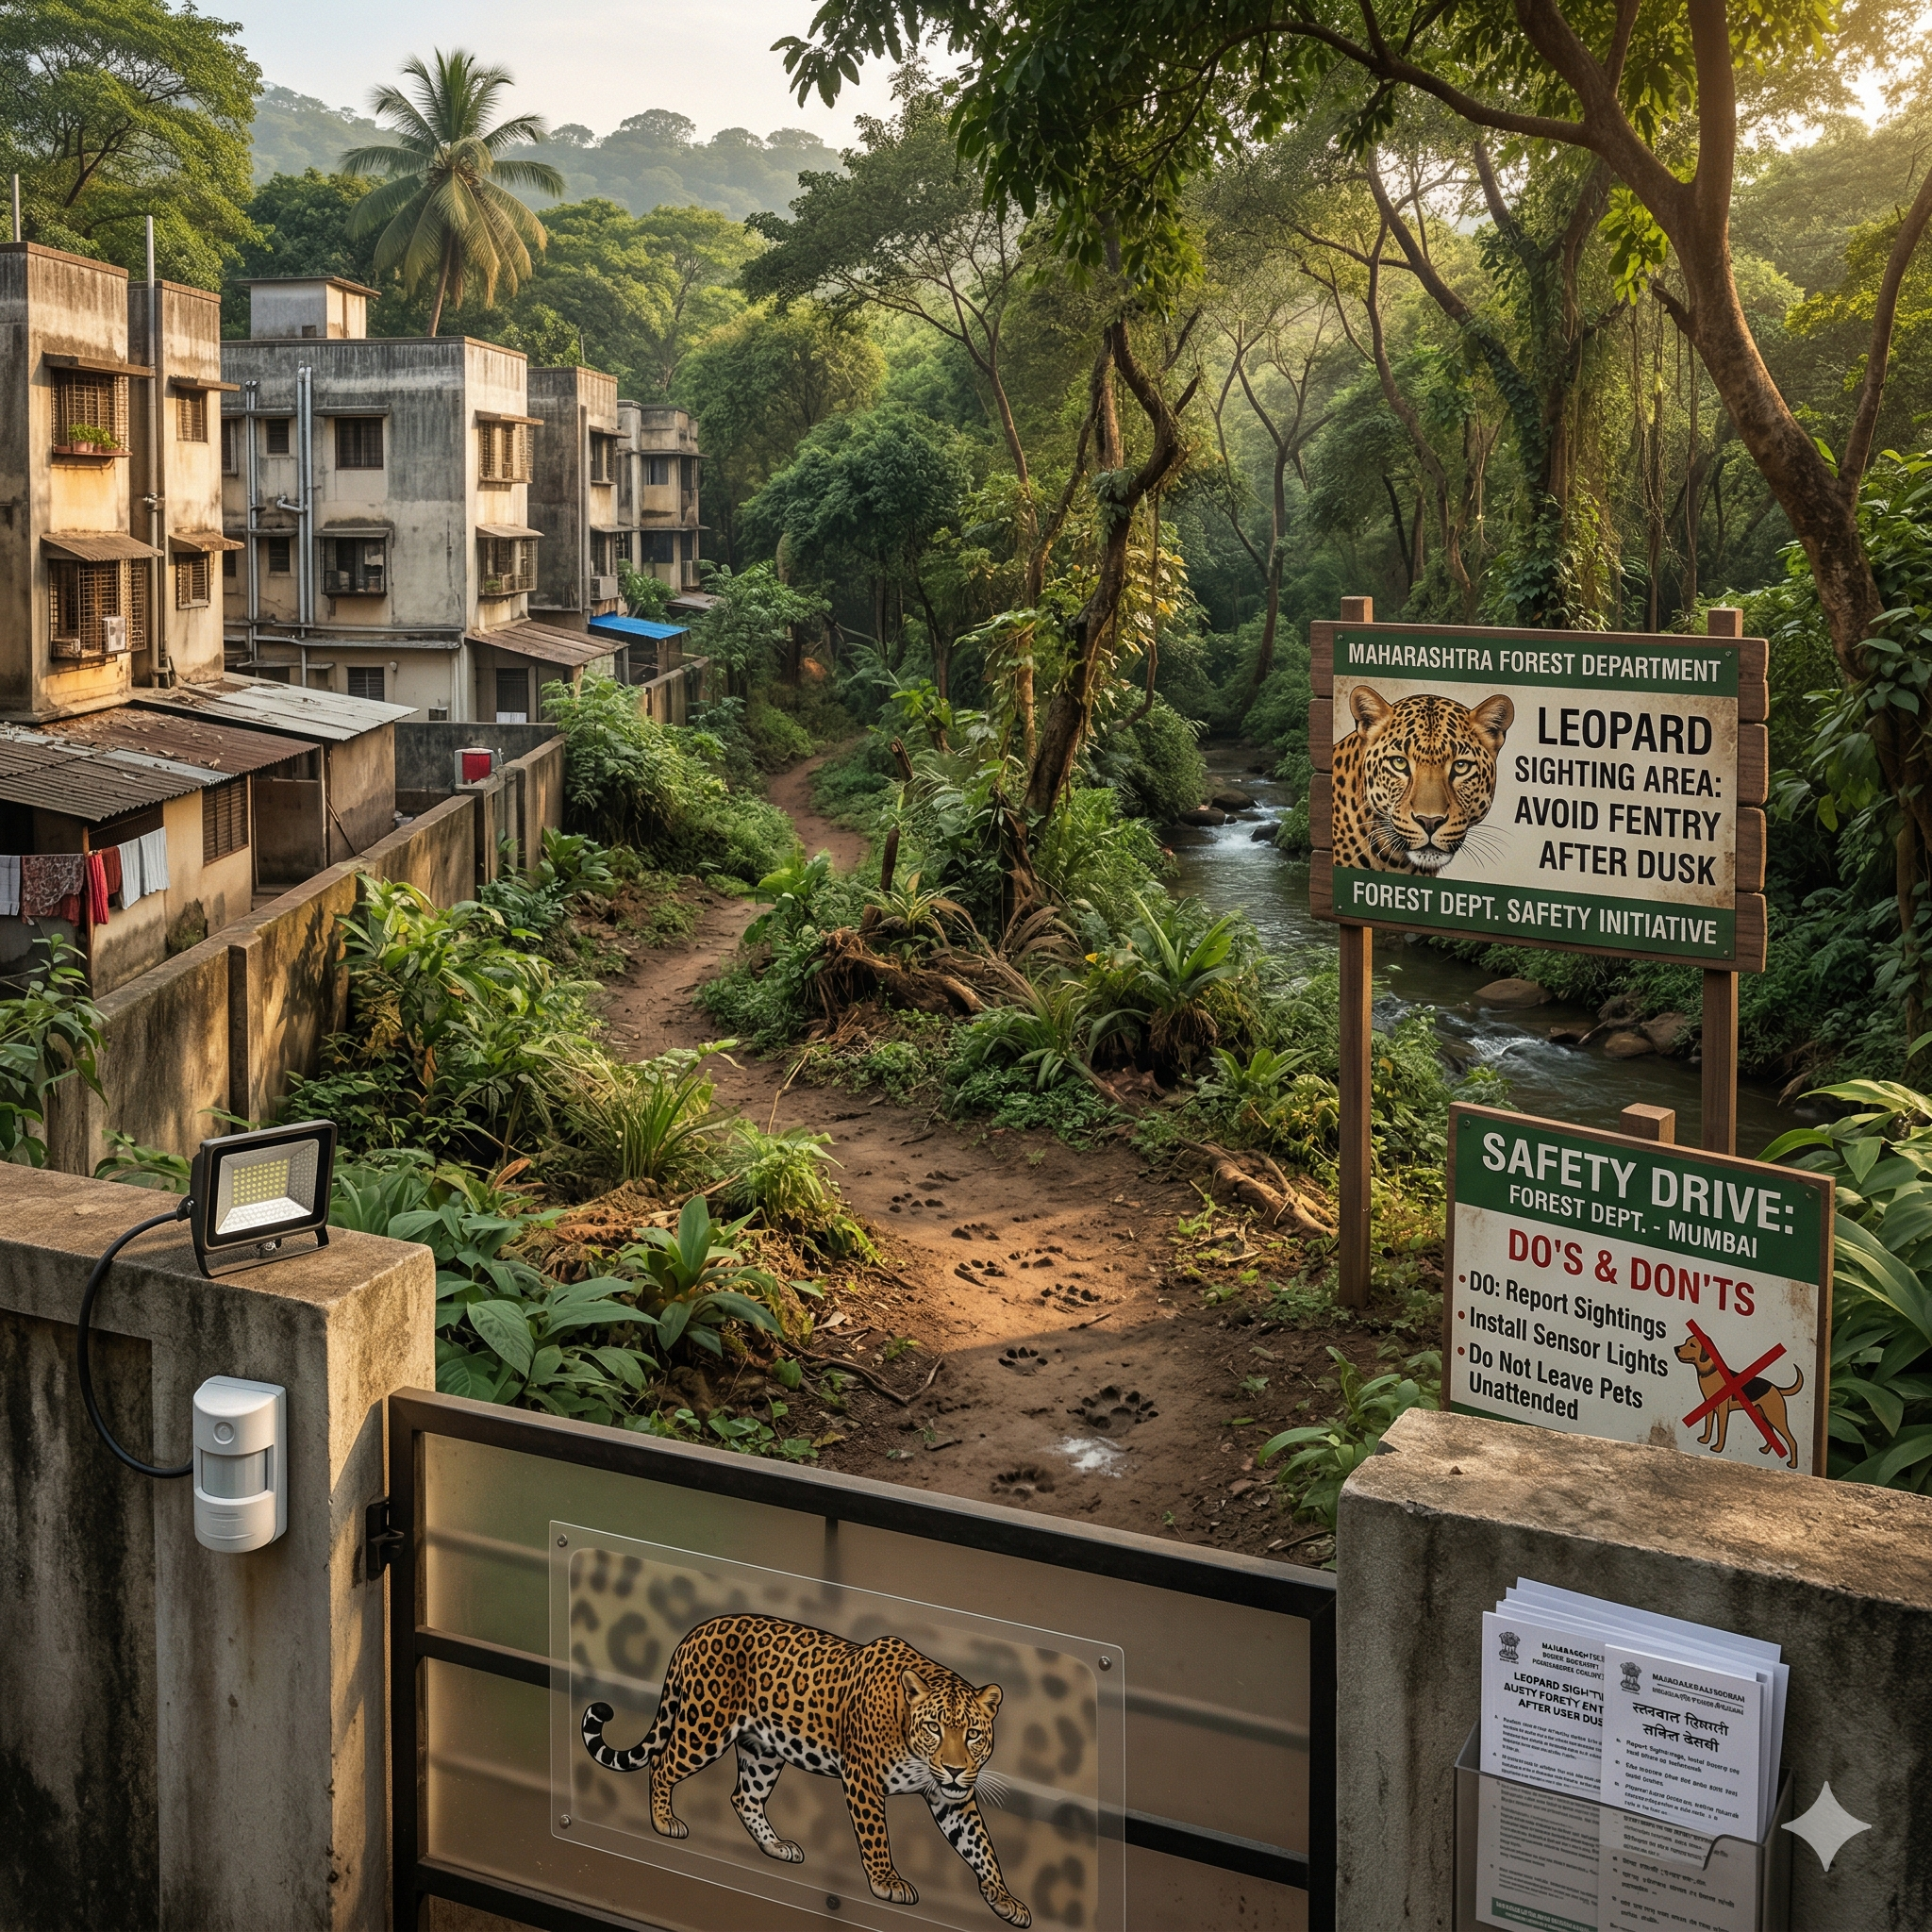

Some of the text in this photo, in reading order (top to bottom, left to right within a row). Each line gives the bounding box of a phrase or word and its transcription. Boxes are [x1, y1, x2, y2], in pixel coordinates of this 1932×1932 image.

[1348, 642, 1721, 682] MAHARASHTRA FOREST DEPARTMENT
[1538, 707, 1712, 755] LEOPARD
[1514, 756, 1722, 798] SIGHTING AREA:
[1514, 796, 1722, 841] AVOID FENTRY
[1539, 841, 1717, 886] AFTER DUSK
[1353, 881, 1717, 944] FOREST DEPT. SAFETY INITIATIVE
[1482, 1132, 1793, 1235] SAFETY DRIVE:
[1509, 1185, 1586, 1220] FOREST
[1591, 1202, 1646, 1234] DEPT.
[1668, 1219, 1757, 1258] MUMBAI
[1508, 1228, 1755, 1317] DO'S & DON'TS
[1469, 1270, 1667, 1341] DO: Report Sightings
[1470, 1307, 1668, 1380] Install Sensor Lights
[1469, 1342, 1643, 1409] Do Not Leave Pets
[1469, 1372, 1578, 1421] Unattended
[1514, 1672, 1559, 1690] LEOPARD
[1518, 1698, 1551, 1714] AFTER
[1553, 1707, 1580, 1722] USER
